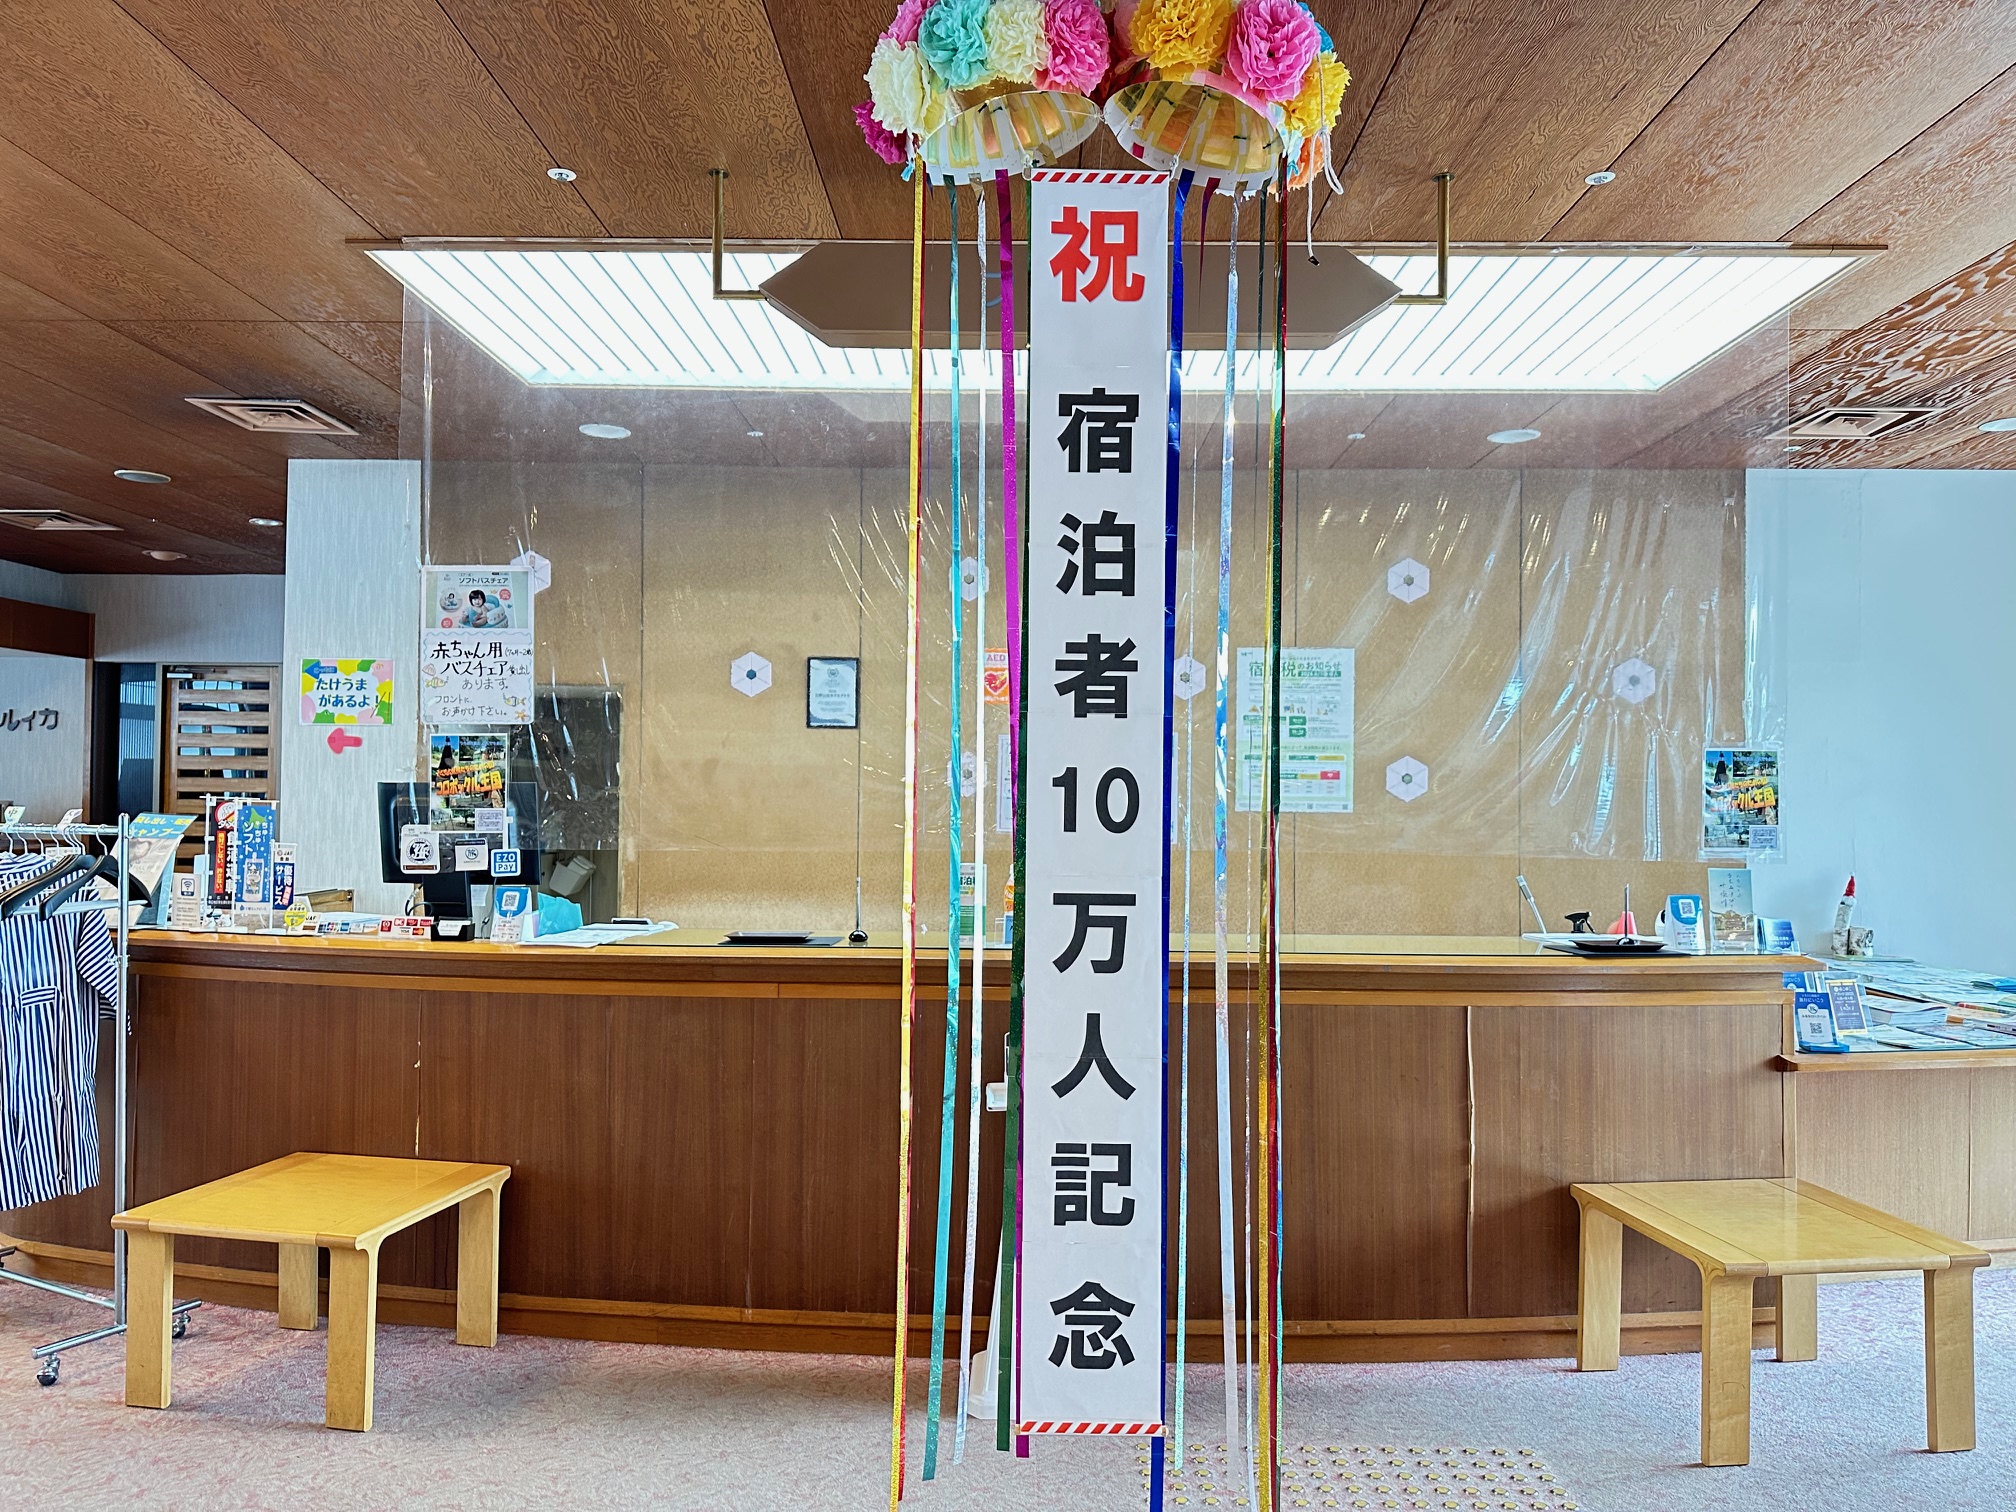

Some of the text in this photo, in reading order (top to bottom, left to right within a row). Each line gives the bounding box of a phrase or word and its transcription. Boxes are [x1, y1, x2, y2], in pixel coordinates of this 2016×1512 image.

[430, 640, 503, 660] 赤ちゃん用
[986, 653, 1006, 662] AED
[440, 660, 508, 678] バスチェア
[1249, 661, 1342, 677] 宿税のお知らせ
[315, 678, 367, 691] たけうま
[318, 694, 379, 708] があるよ！
[0, 707, 59, 732] ルイカ
[436, 770, 503, 797] コロボックル王国
[1047, 205, 1146, 1371] 祝 宿泊者10万人記念
[243, 821, 254, 856] ソフト
[496, 852, 516, 862] EZO
[497, 863, 514, 872] Pay
[274, 865, 284, 906] サービス
